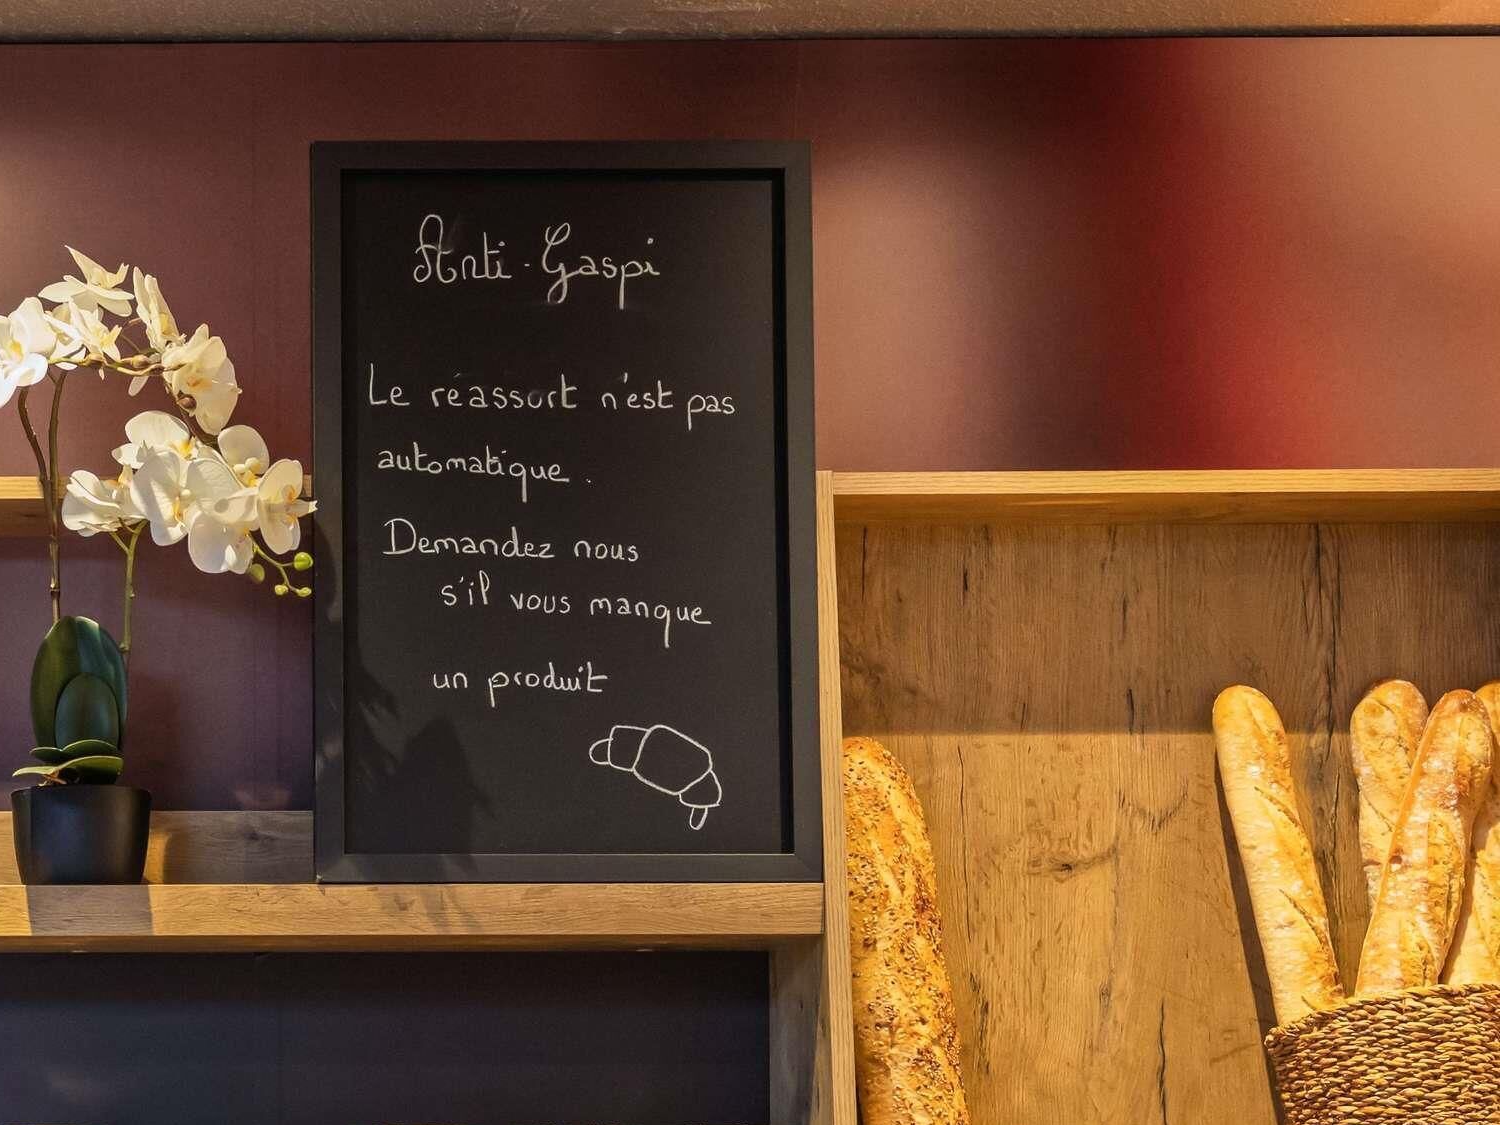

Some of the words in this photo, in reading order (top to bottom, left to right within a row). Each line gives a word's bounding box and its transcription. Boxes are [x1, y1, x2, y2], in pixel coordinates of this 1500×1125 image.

[368, 362, 411, 407] Le
[431, 372, 578, 410] réassort
[601, 372, 674, 410] n'est
[687, 394, 736, 432] pas
[382, 517, 556, 559] Demandez
[573, 540, 639, 562] nous
[440, 569, 491, 607] s'il
[509, 592, 571, 614] vous
[589, 597, 712, 649] manque
[432, 671, 468, 689] un
[487, 661, 609, 708] produit
